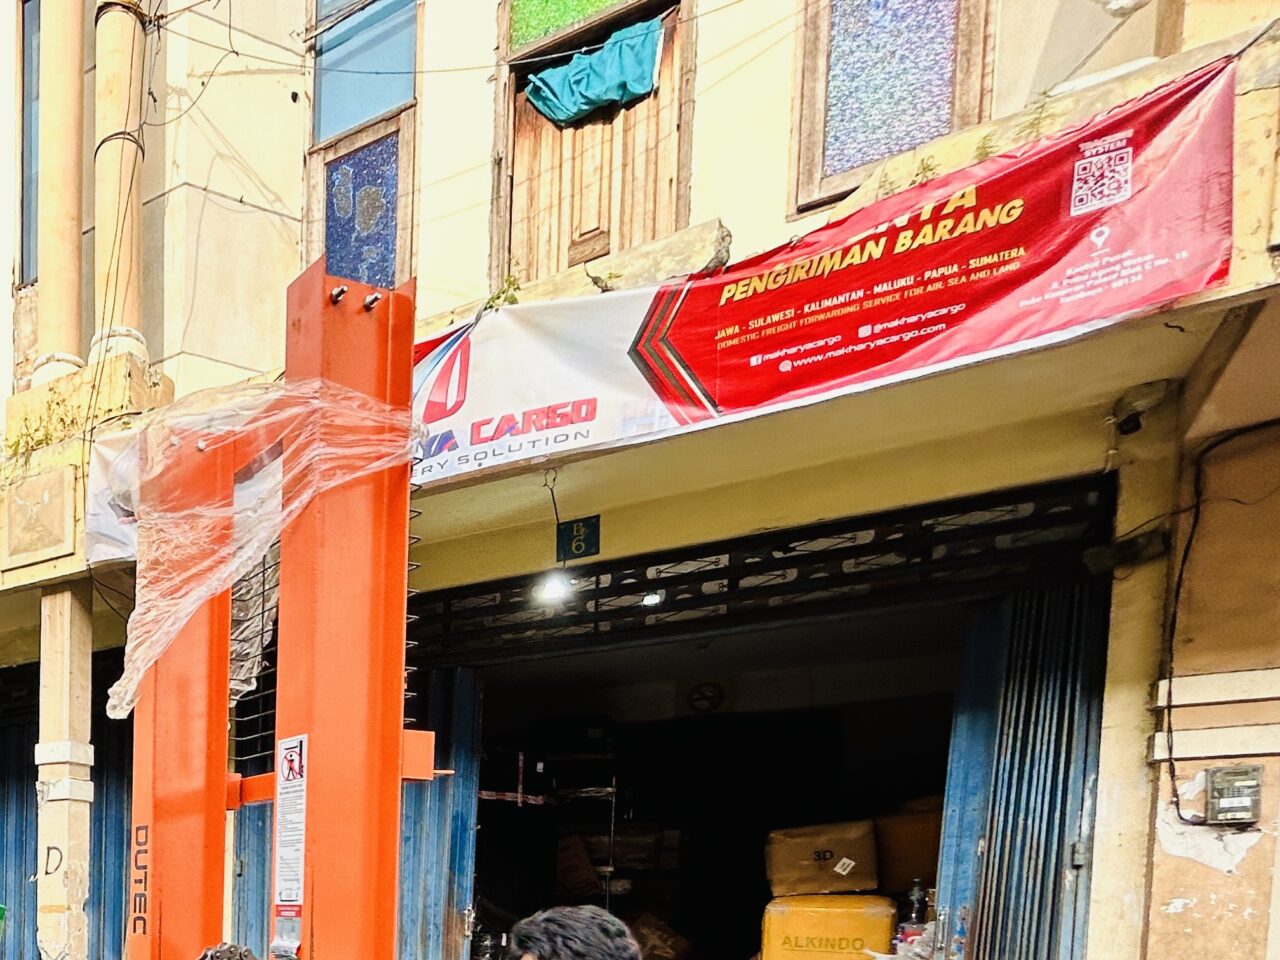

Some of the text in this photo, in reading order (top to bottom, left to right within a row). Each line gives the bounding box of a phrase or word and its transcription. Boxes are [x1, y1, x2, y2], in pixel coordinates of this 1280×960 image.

[1083, 139, 1127, 158] SYSTEM
[719, 237, 886, 306] PENGIRIMAN
[894, 198, 1025, 253] BARANG
[715, 325, 739, 340] JAWA
[748, 308, 795, 330] SULAWESI
[803, 289, 864, 314] KALIMANTAN
[873, 275, 915, 295] MALUKU
[924, 264, 959, 281] PAPUA
[968, 247, 1026, 270] SUMATERA
[717, 332, 759, 350] DOMESTIC
[761, 321, 798, 337] FREIGHT
[799, 303, 860, 327] FORWARDING
[862, 292, 901, 309] SERVICE
[904, 286, 924, 299] FOR
[947, 275, 967, 287] SEA
[969, 269, 991, 281] AND
[993, 261, 1021, 275] LAND
[470, 397, 598, 446] CARGO
[457, 429, 590, 464] SOLUTION
[45, 846, 63, 876] D
[132, 824, 149, 936] DUTEC
[781, 935, 865, 951] ALKINDO
